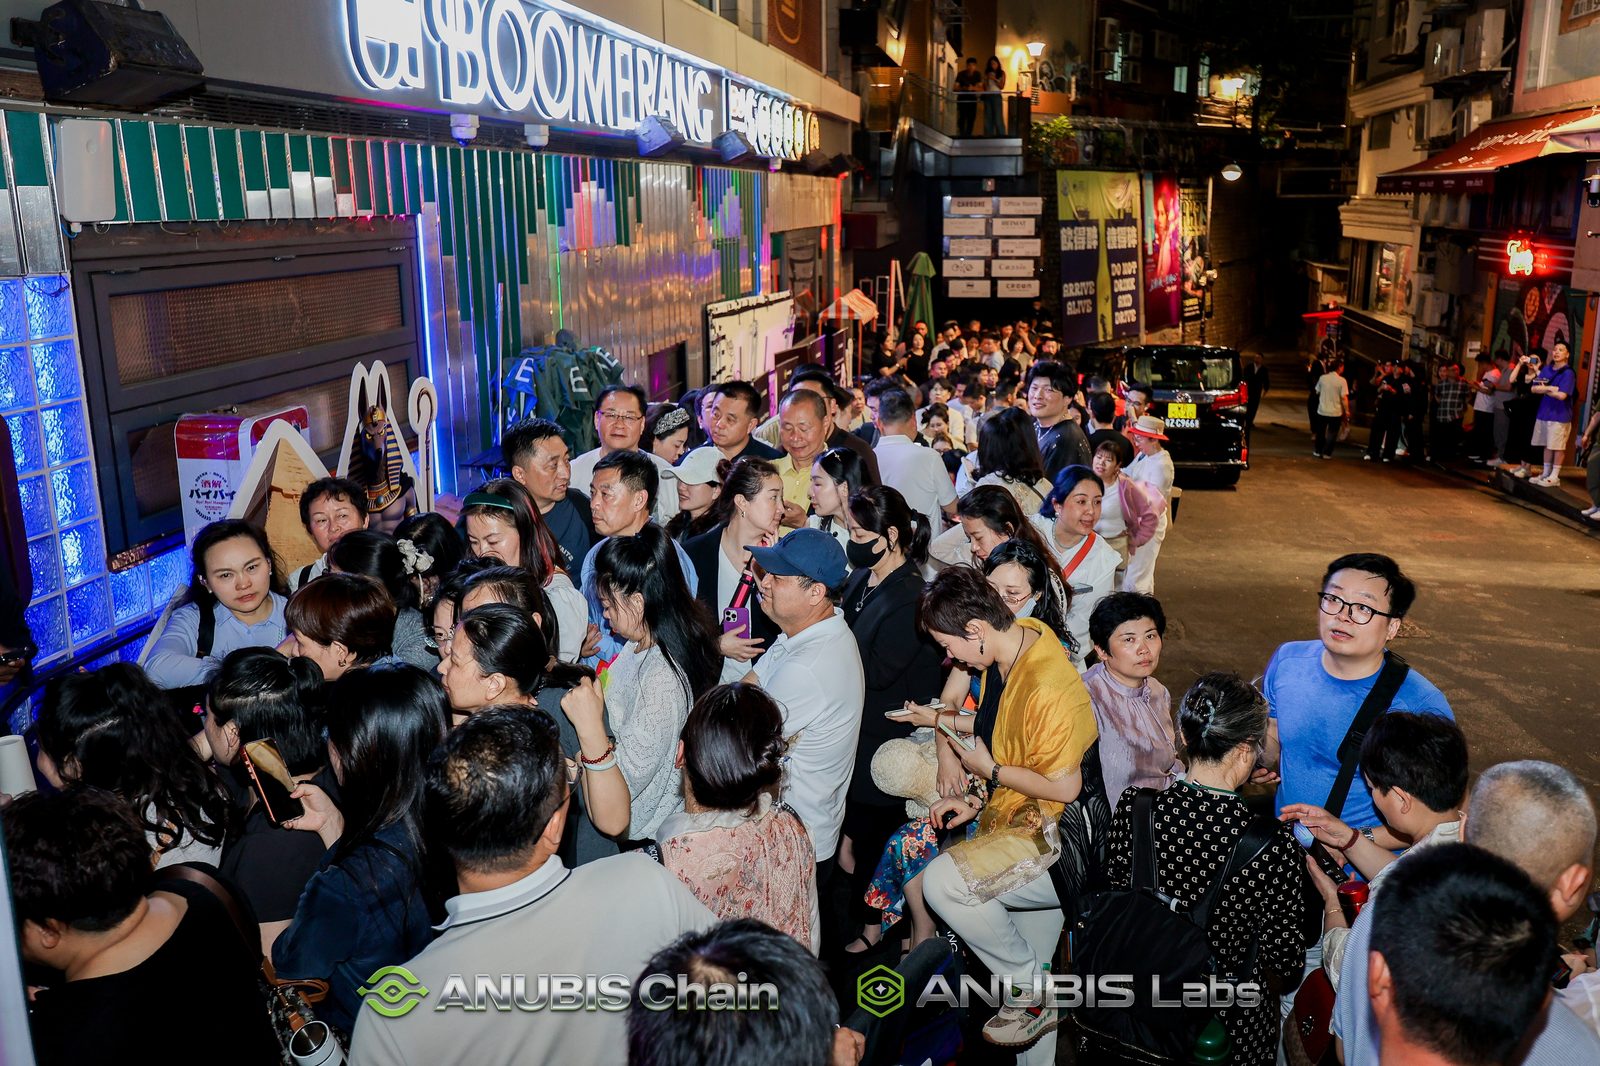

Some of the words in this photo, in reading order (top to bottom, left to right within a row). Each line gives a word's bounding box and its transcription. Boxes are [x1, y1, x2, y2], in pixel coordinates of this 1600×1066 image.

[426, 0, 713, 143] BOOMERANG
[1111, 263, 1121, 276] DO
[1122, 261, 1138, 275] NOT
[1063, 280, 1096, 298] ARRIVE
[1114, 277, 1136, 293] DRINK
[1066, 299, 1093, 316] ALIVE
[1117, 293, 1133, 309] AND
[1114, 309, 1137, 325] DRIVE
[189, 488, 236, 501] バイバイ
